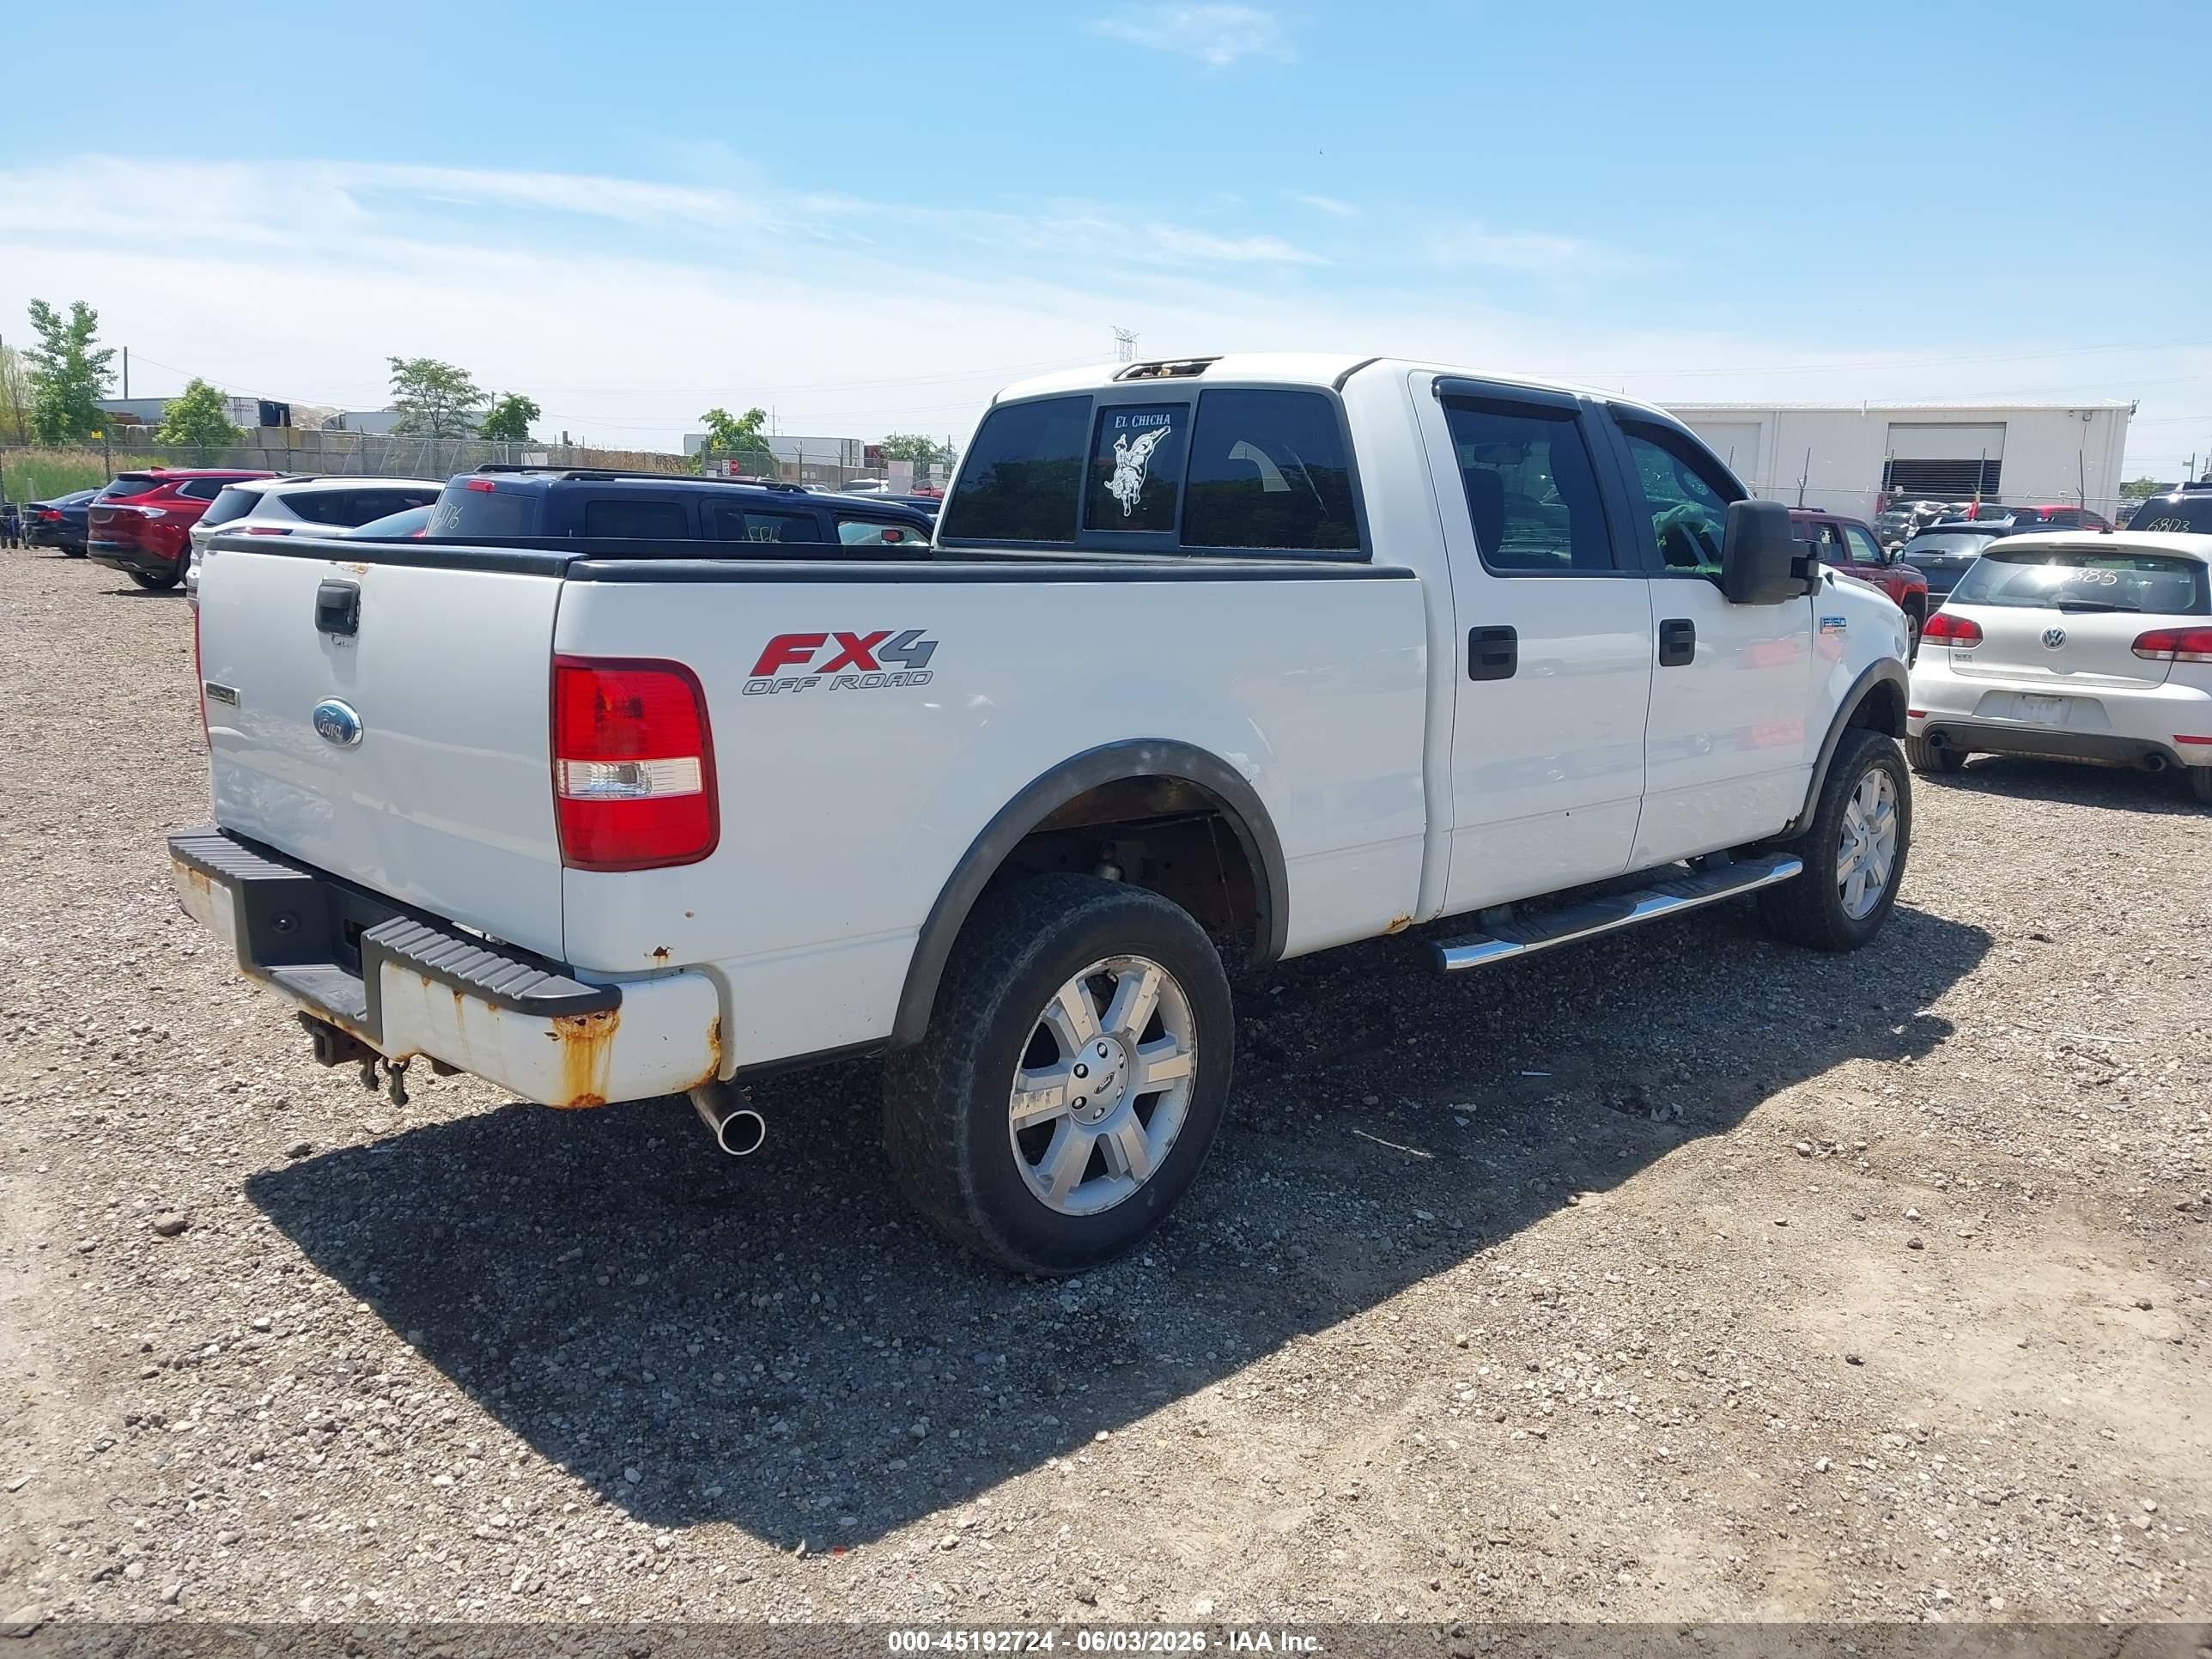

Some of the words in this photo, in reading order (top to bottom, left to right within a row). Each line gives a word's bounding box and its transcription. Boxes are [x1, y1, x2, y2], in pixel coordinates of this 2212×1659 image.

[1115, 416, 1127, 428] EL
[1132, 414, 1170, 427] CHICHA
[749, 629, 939, 677] FX4
[742, 677, 822, 696] OFF
[829, 671, 934, 690] ROAD
